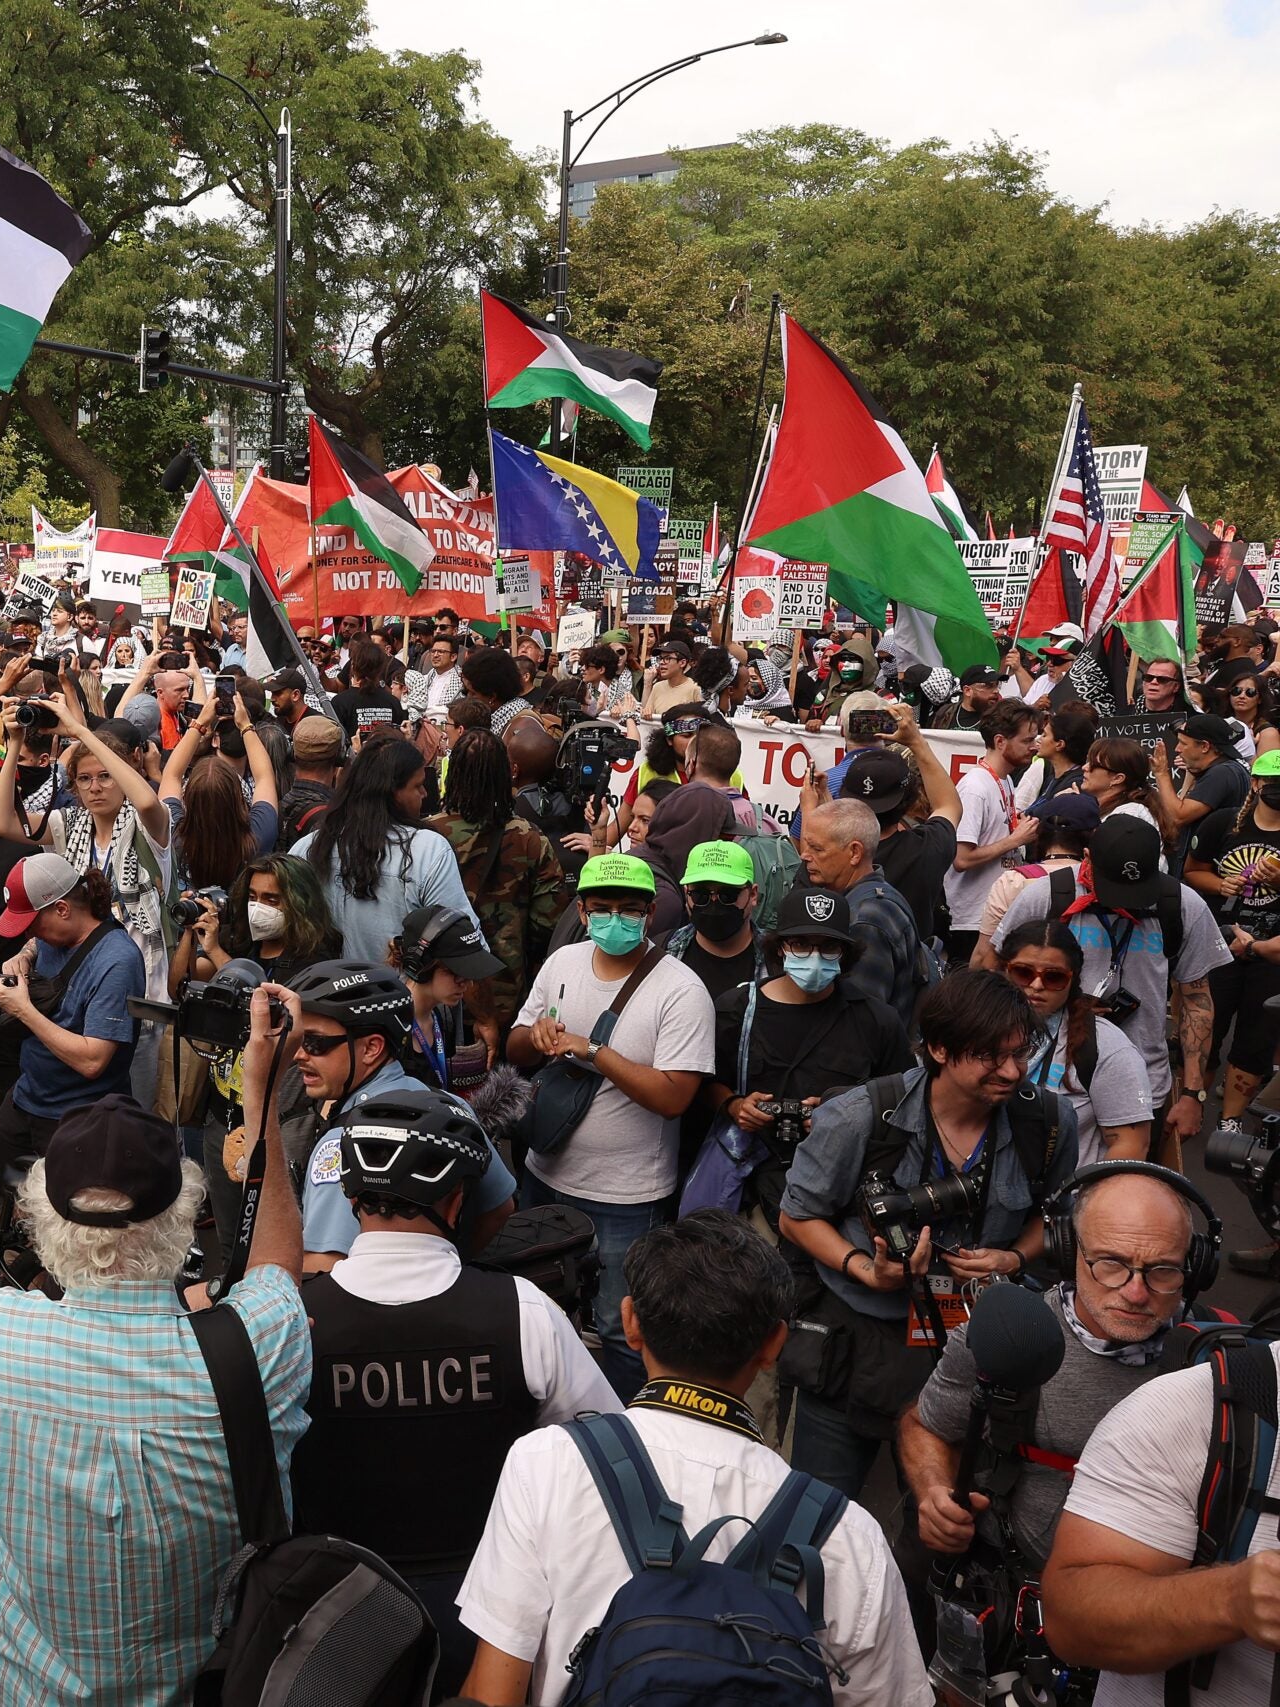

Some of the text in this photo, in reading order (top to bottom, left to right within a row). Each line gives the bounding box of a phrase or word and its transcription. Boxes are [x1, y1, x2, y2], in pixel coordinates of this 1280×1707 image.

[1105, 470, 1119, 478] THE
[618, 476, 671, 488] CHICAGO
[221, 493, 231, 501] TO
[404, 491, 495, 533] ALESTIN
[433, 528, 453, 550] TO
[307, 535, 347, 556] END
[958, 543, 1009, 559] VICTORY
[36, 549, 52, 559] State
[53, 549, 59, 559] of
[341, 556, 359, 565] FOR
[784, 563, 828, 573] STAND WITH
[181, 570, 197, 582] NO
[783, 571, 827, 581] PALESTINE!
[20, 573, 56, 600] VICTORY
[332, 571, 492, 595] NOT GENOCID
[783, 583, 823, 594] END U.S
[631, 586, 673, 596] OF GAZA
[195, 600, 206, 610] IN
[782, 593, 823, 605] AID TO
[174, 601, 206, 625] APARTHEID
[781, 605, 822, 616] ISRAEL!
[564, 621, 583, 630] WELCOME
[736, 619, 750, 632] NOT
[1116, 723, 1151, 736] VOTE
[758, 741, 816, 788] TO
[703, 847, 729, 856] National
[600, 859, 629, 867] National
[332, 972, 370, 991] POLICE
[436, 1036, 444, 1054] DNC
[363, 1176, 391, 1185] QUANTUM
[240, 1189, 258, 1247] SONY
[331, 1354, 494, 1409] POLICE
[663, 1385, 728, 1417] Nikon
